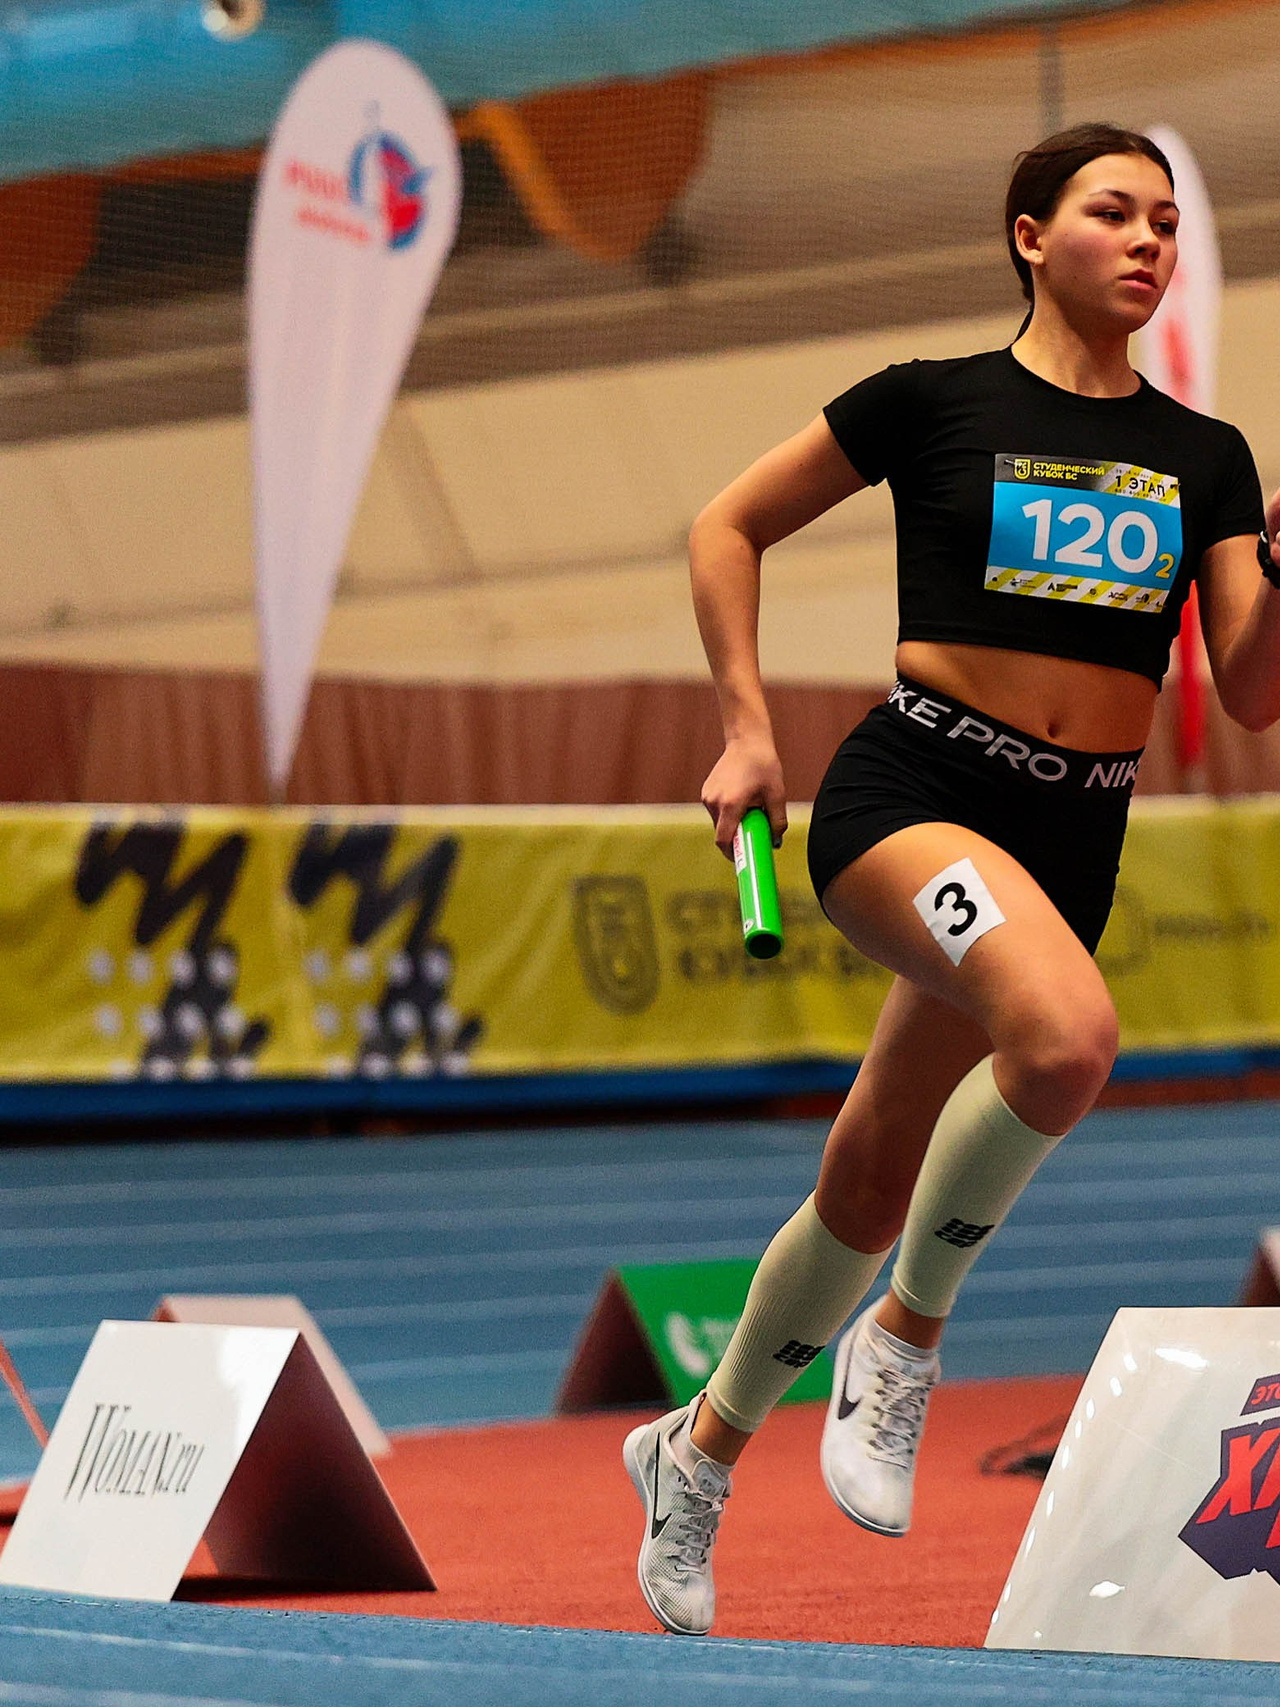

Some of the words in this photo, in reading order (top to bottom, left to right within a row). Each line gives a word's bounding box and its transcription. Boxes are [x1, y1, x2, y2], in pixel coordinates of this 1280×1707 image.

[1033, 462, 1105, 476] СТУДЕНЧЕСКИЙ
[1033, 470, 1064, 479] КУБОК
[1115, 475, 1122, 488] 1
[1128, 477, 1166, 497] ЭТАП
[1021, 499, 1159, 574] 120
[1155, 553, 1175, 579] 2
[888, 683, 952, 729] KE
[946, 715, 1068, 782] PRO
[1084, 758, 1141, 788] NIK
[934, 882, 978, 937] 3
